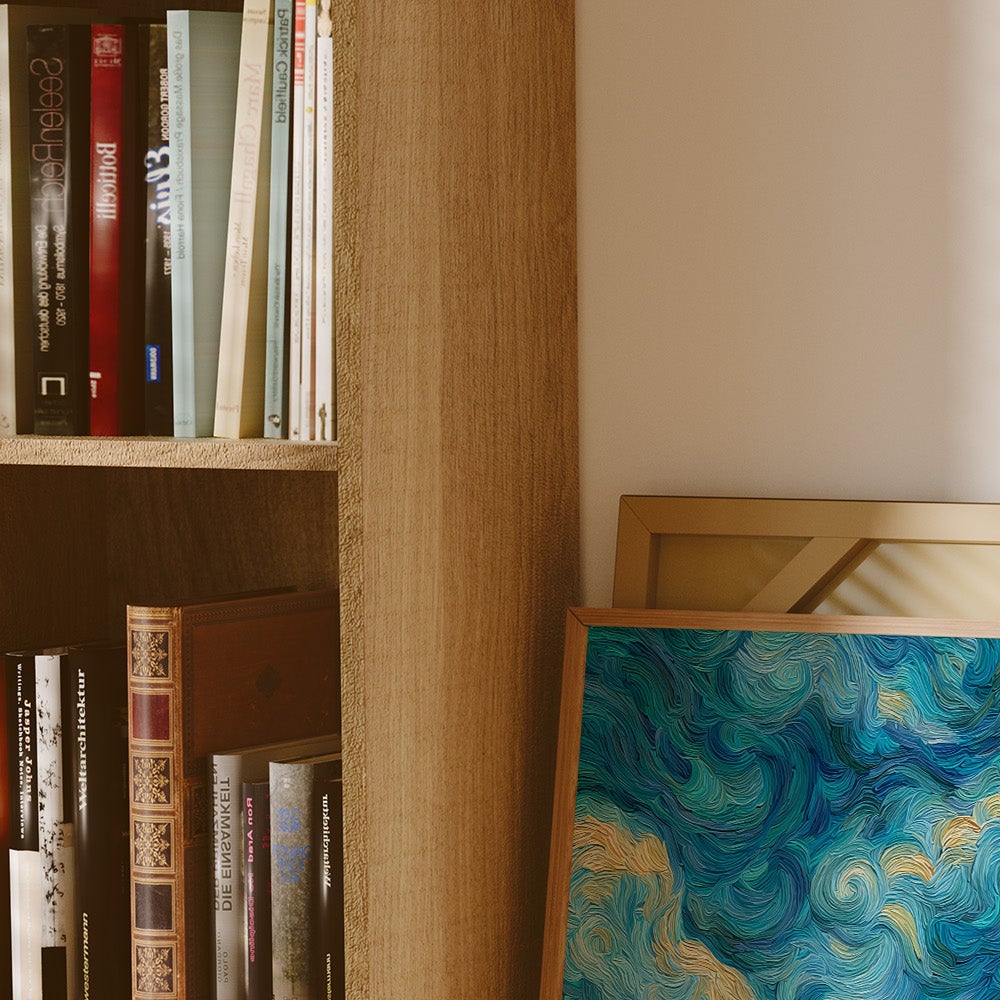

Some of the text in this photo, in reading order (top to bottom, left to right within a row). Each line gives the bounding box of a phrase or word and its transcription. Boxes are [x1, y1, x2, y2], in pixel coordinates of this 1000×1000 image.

[23, 700, 33, 803] Jasper Johns
[77, 668, 87, 811] Weltarchitektur
